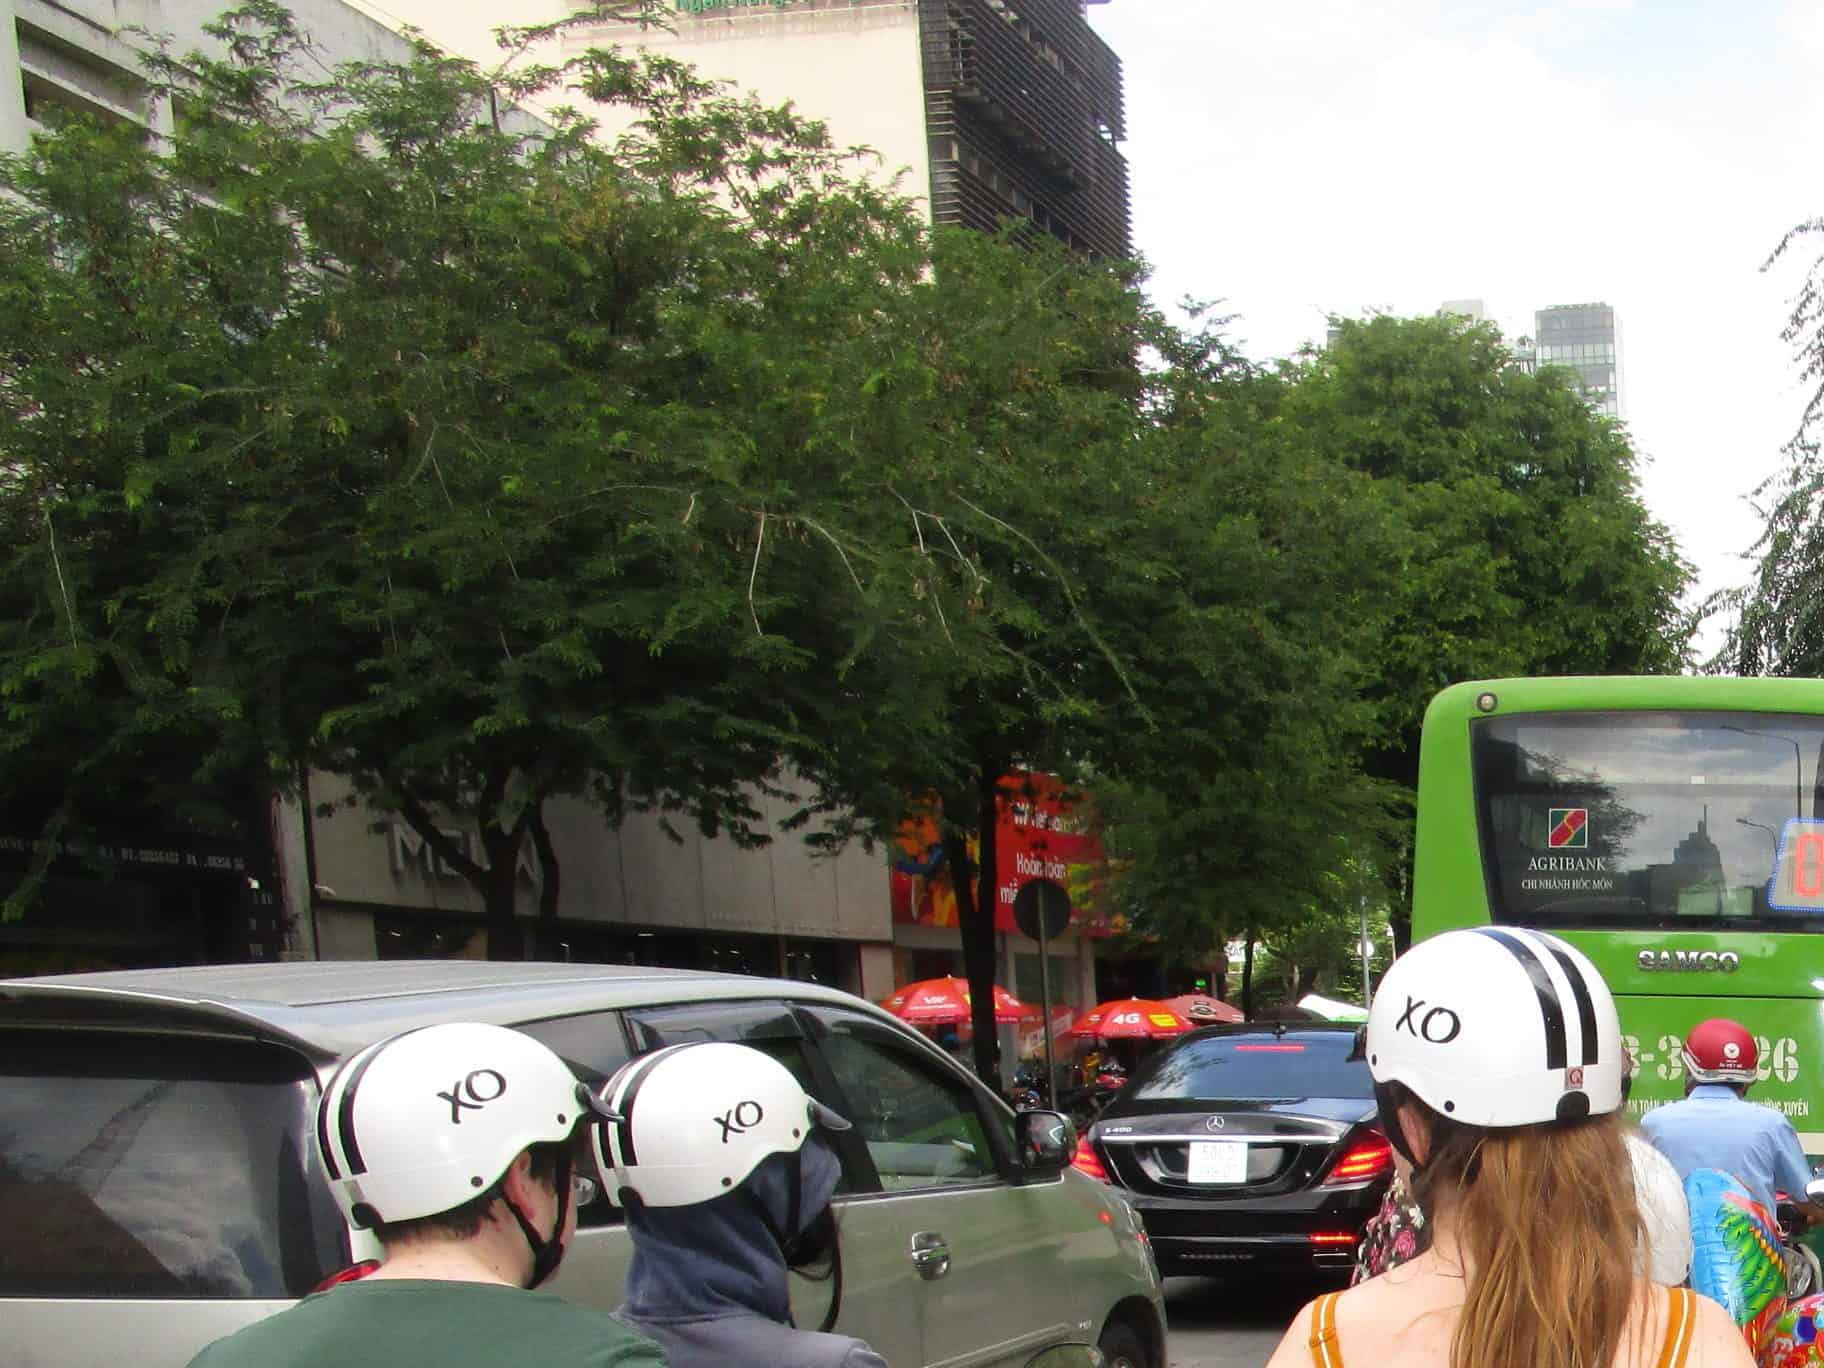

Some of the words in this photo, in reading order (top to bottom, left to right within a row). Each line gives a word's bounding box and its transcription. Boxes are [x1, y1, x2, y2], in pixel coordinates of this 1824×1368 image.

[1528, 856, 1607, 871] AGRIBANK
[1522, 880, 1537, 889] CHI
[1638, 951, 1739, 971] SAMCO
[1112, 1013, 1140, 1025] 4G
[1396, 995, 1461, 1044] XO
[436, 1068, 507, 1125] XO
[713, 1099, 764, 1144] XO
